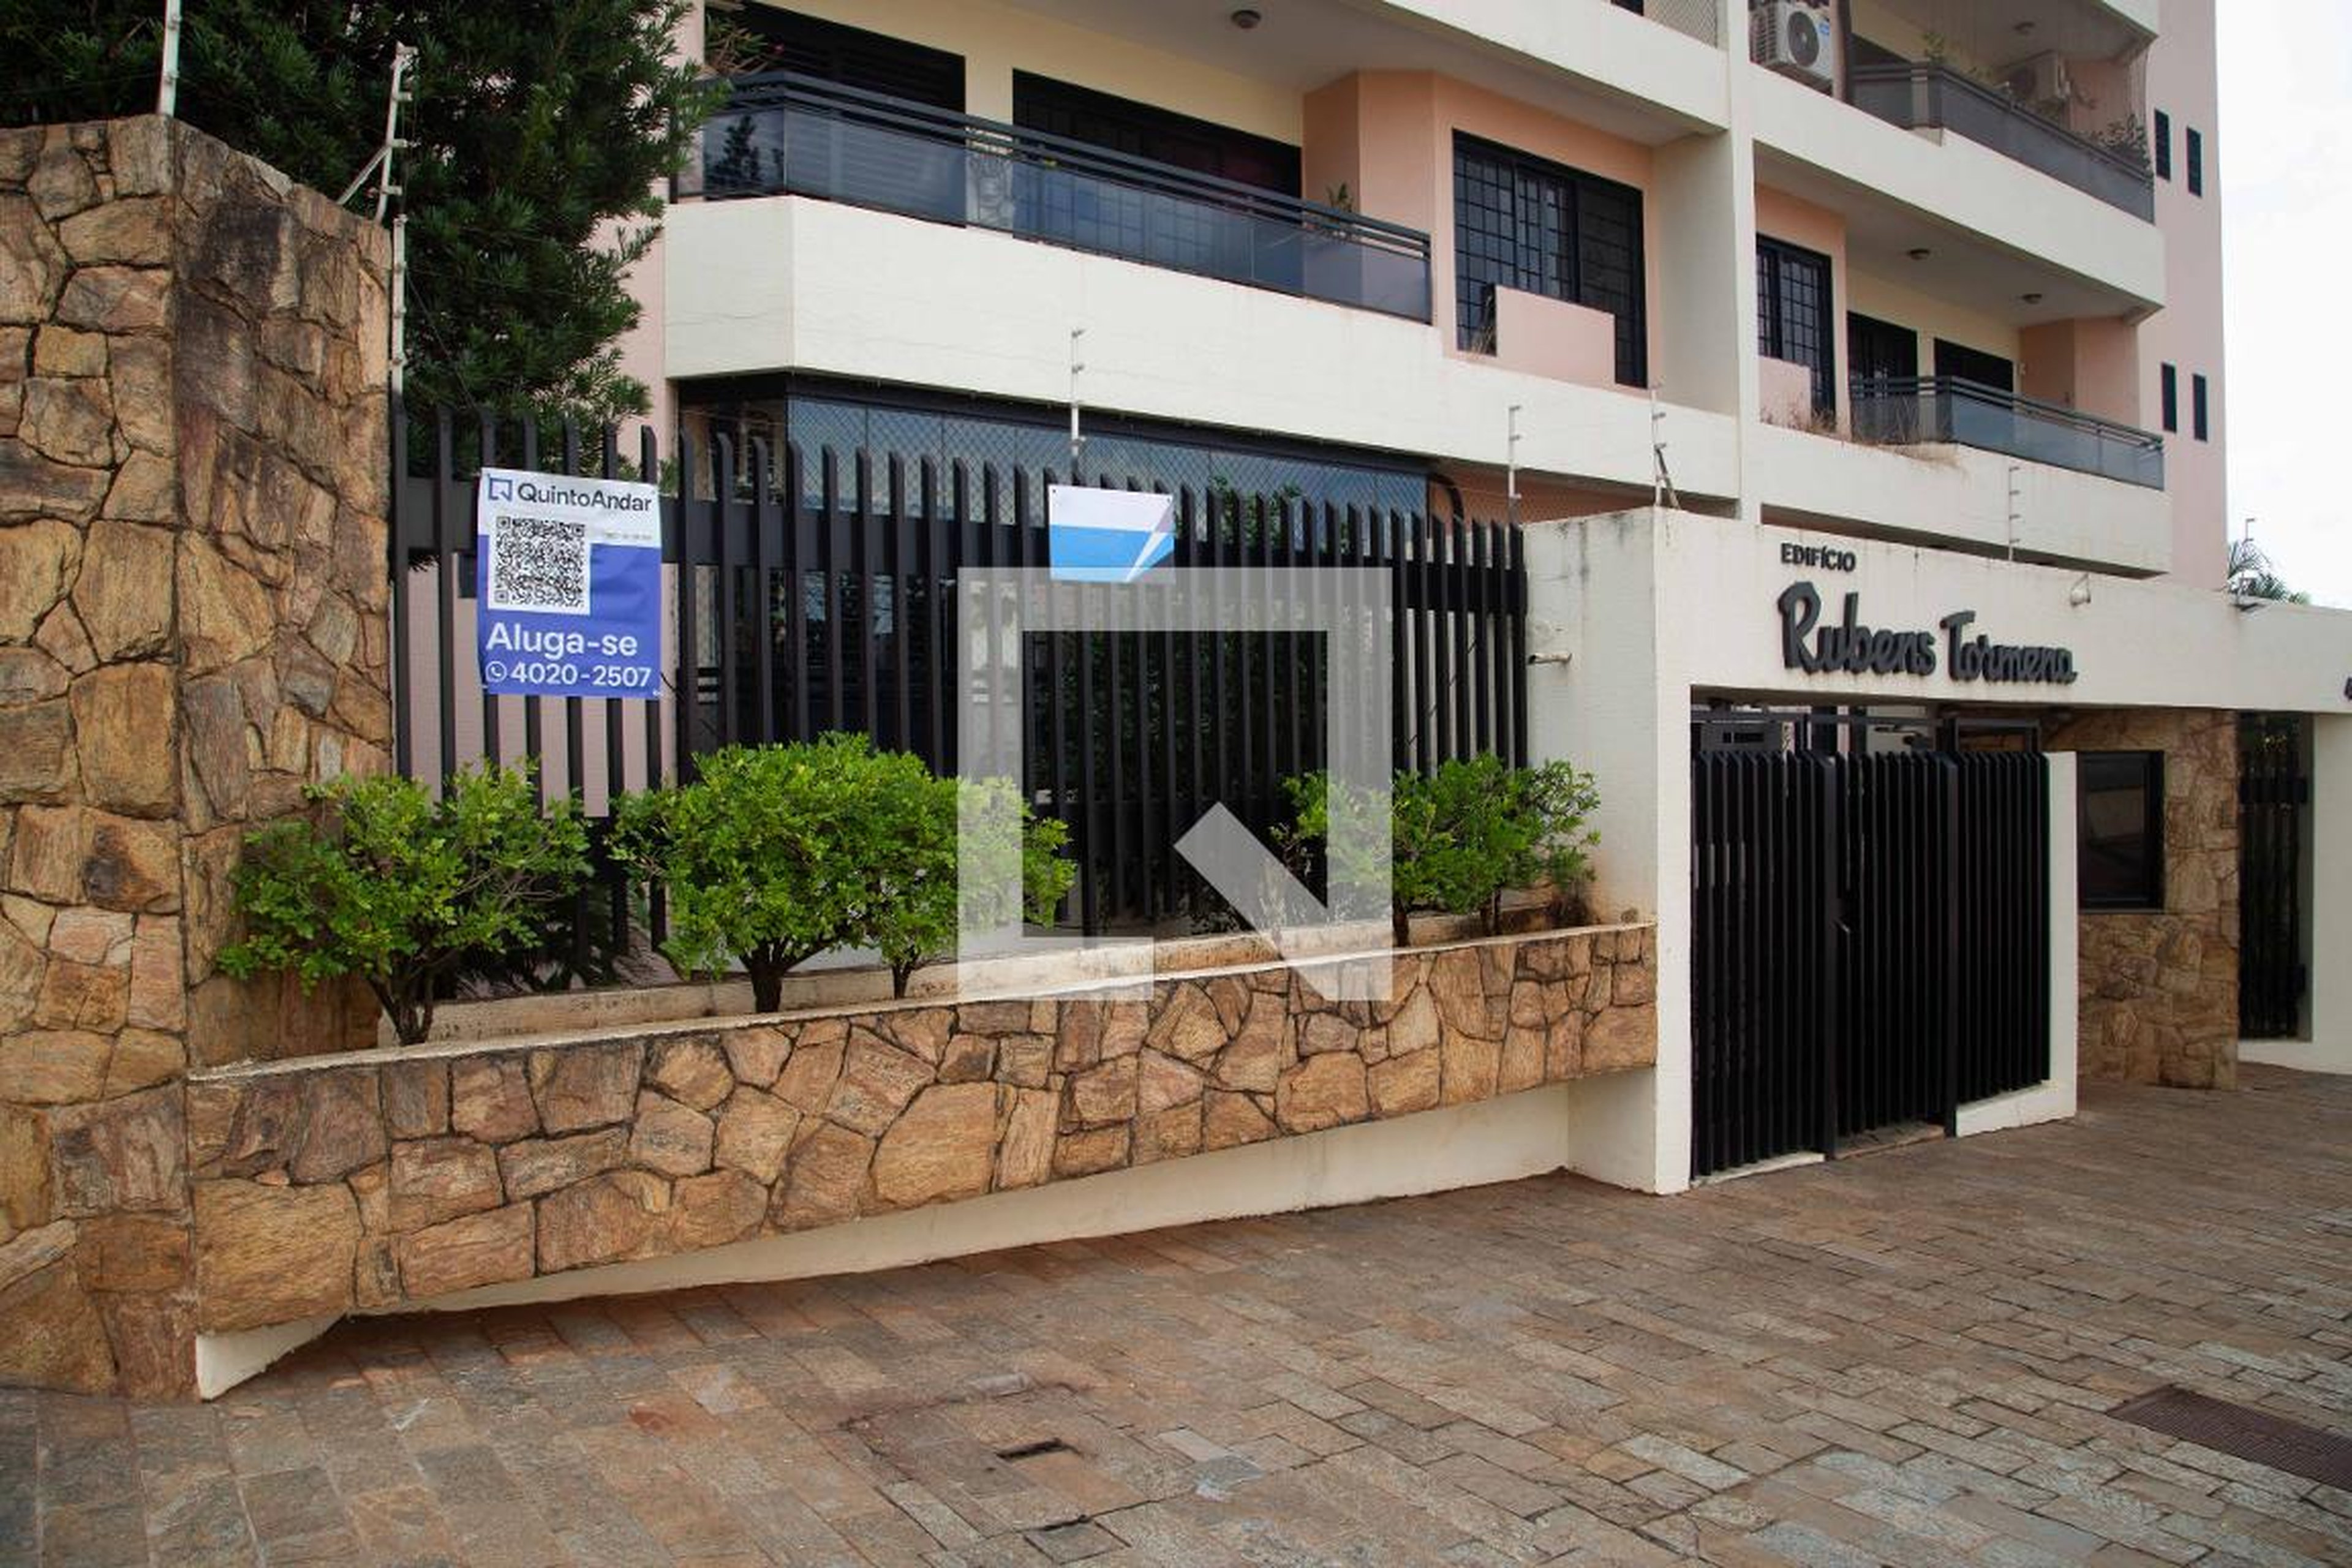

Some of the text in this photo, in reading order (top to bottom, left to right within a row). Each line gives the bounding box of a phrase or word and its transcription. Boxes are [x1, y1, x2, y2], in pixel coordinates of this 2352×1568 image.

[518, 483, 652, 511] QuintoAndar
[1781, 542, 1856, 572] EDIFÍCIO
[486, 622, 638, 659] Aluga-se
[1777, 581, 1936, 676] Rubens
[511, 662, 652, 687] 4020-2507
